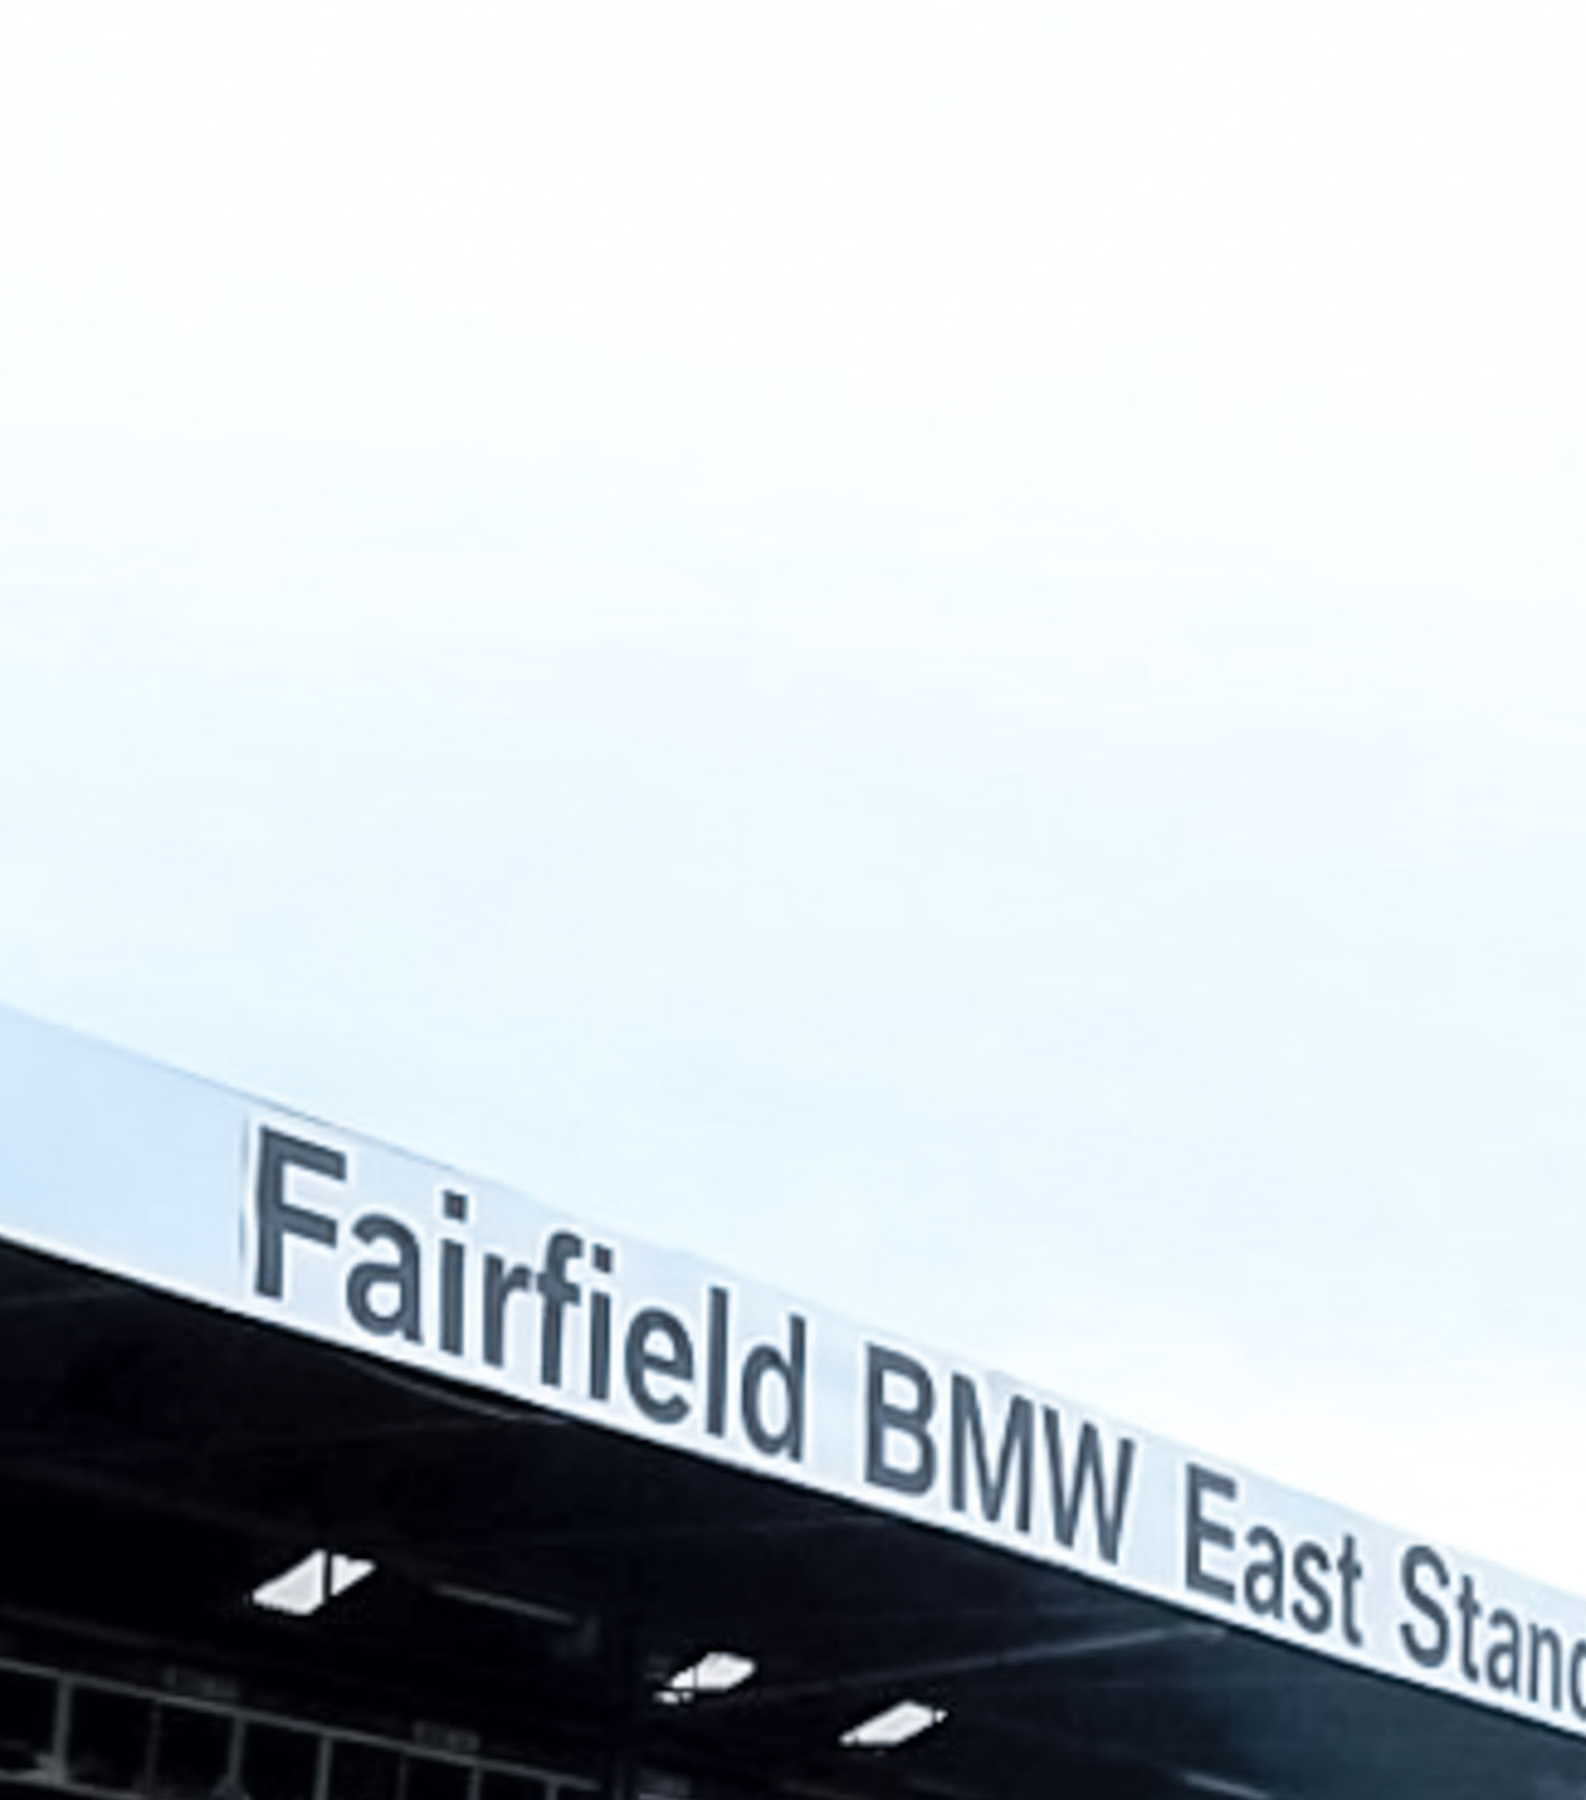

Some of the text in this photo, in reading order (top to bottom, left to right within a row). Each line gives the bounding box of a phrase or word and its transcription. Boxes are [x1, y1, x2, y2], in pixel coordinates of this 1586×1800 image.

[254, 1124, 807, 1464] Fairfield
[864, 1344, 1135, 1566] BMW
[1185, 1463, 1362, 1648] East
